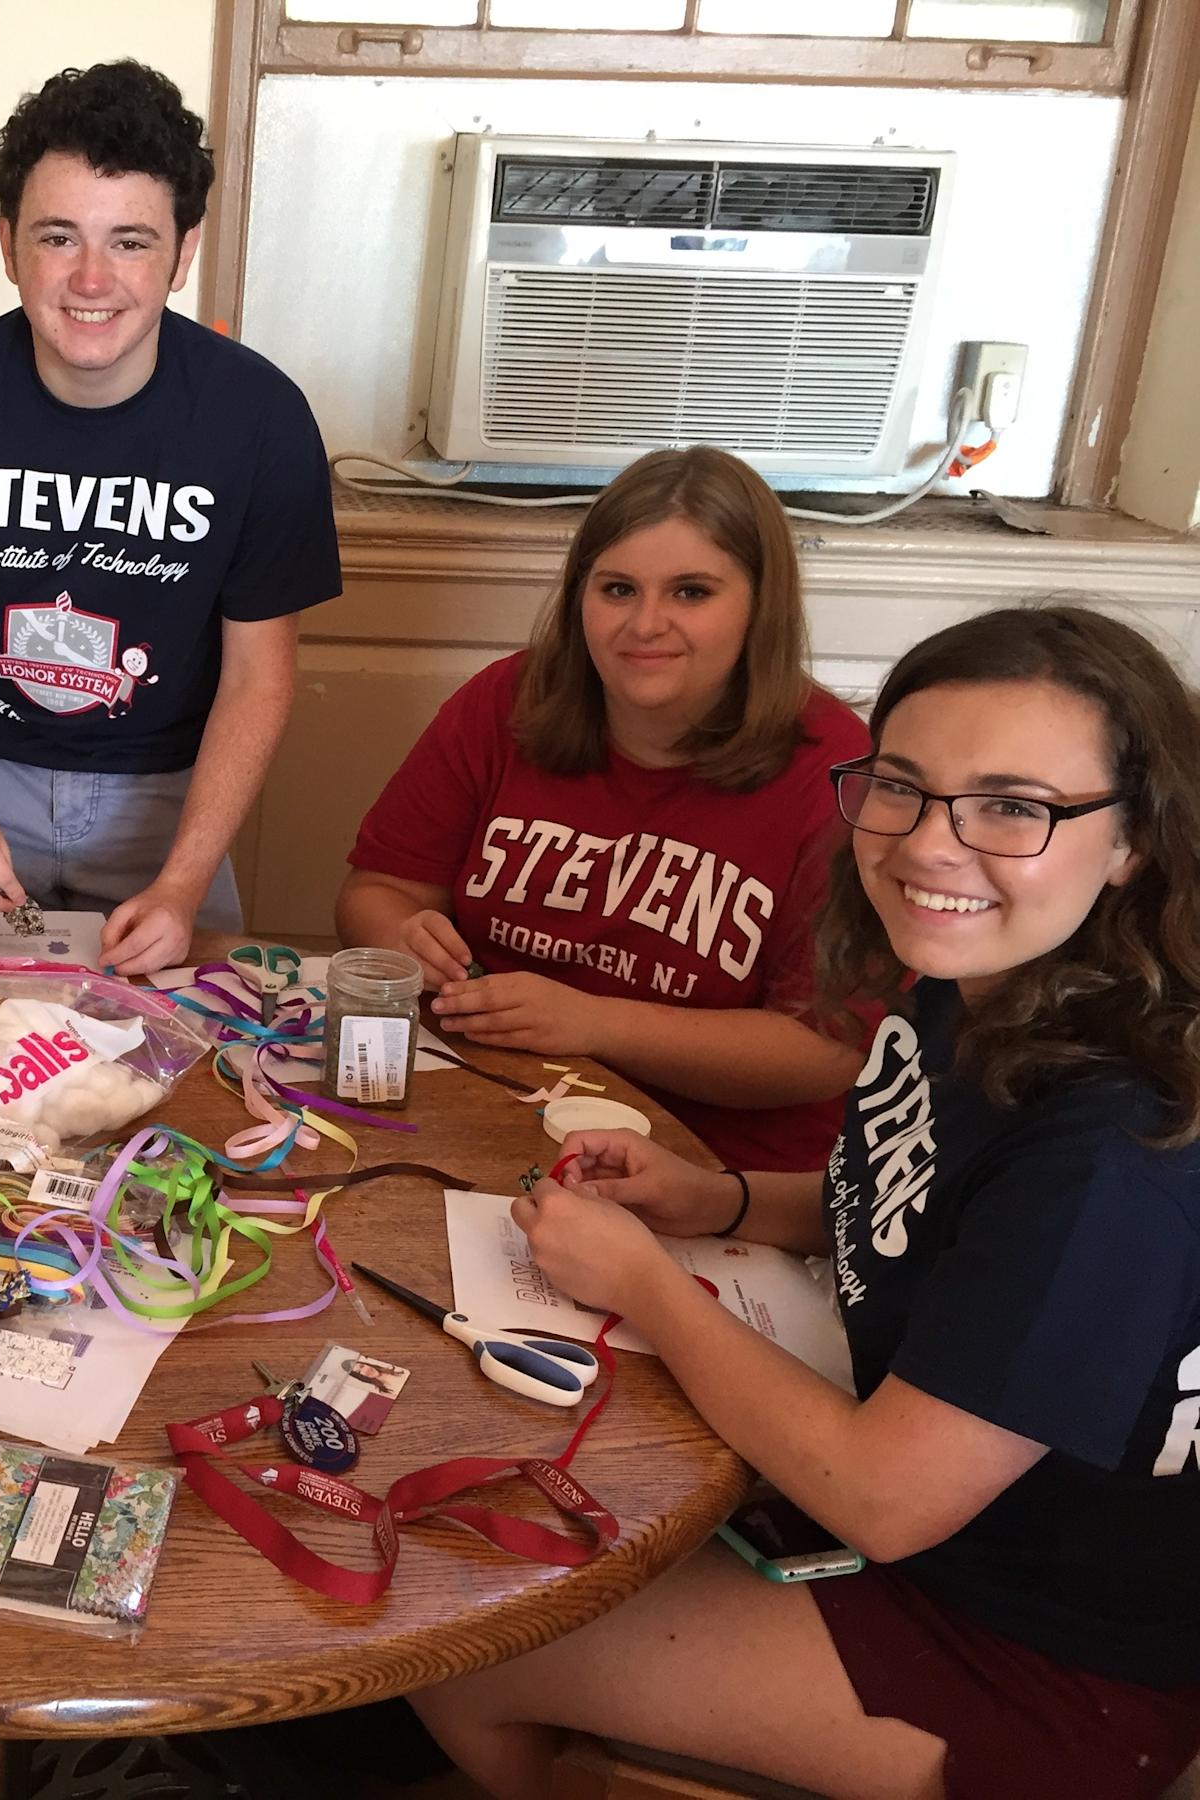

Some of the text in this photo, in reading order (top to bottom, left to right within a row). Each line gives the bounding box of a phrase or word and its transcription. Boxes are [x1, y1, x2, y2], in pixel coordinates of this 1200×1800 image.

[51, 542, 79, 571] of
[80, 542, 190, 582] Technology
[1, 663, 115, 699] HONOR SYSTEM
[465, 815, 774, 982] STEVENS
[650, 962, 698, 999] NJ
[294, 1419, 316, 1452] AWARD
[304, 1421, 325, 1448] GAME
[313, 1416, 345, 1451] 200
[296, 1481, 363, 1517] STEVENS
[71, 1511, 96, 1548] HELLO
